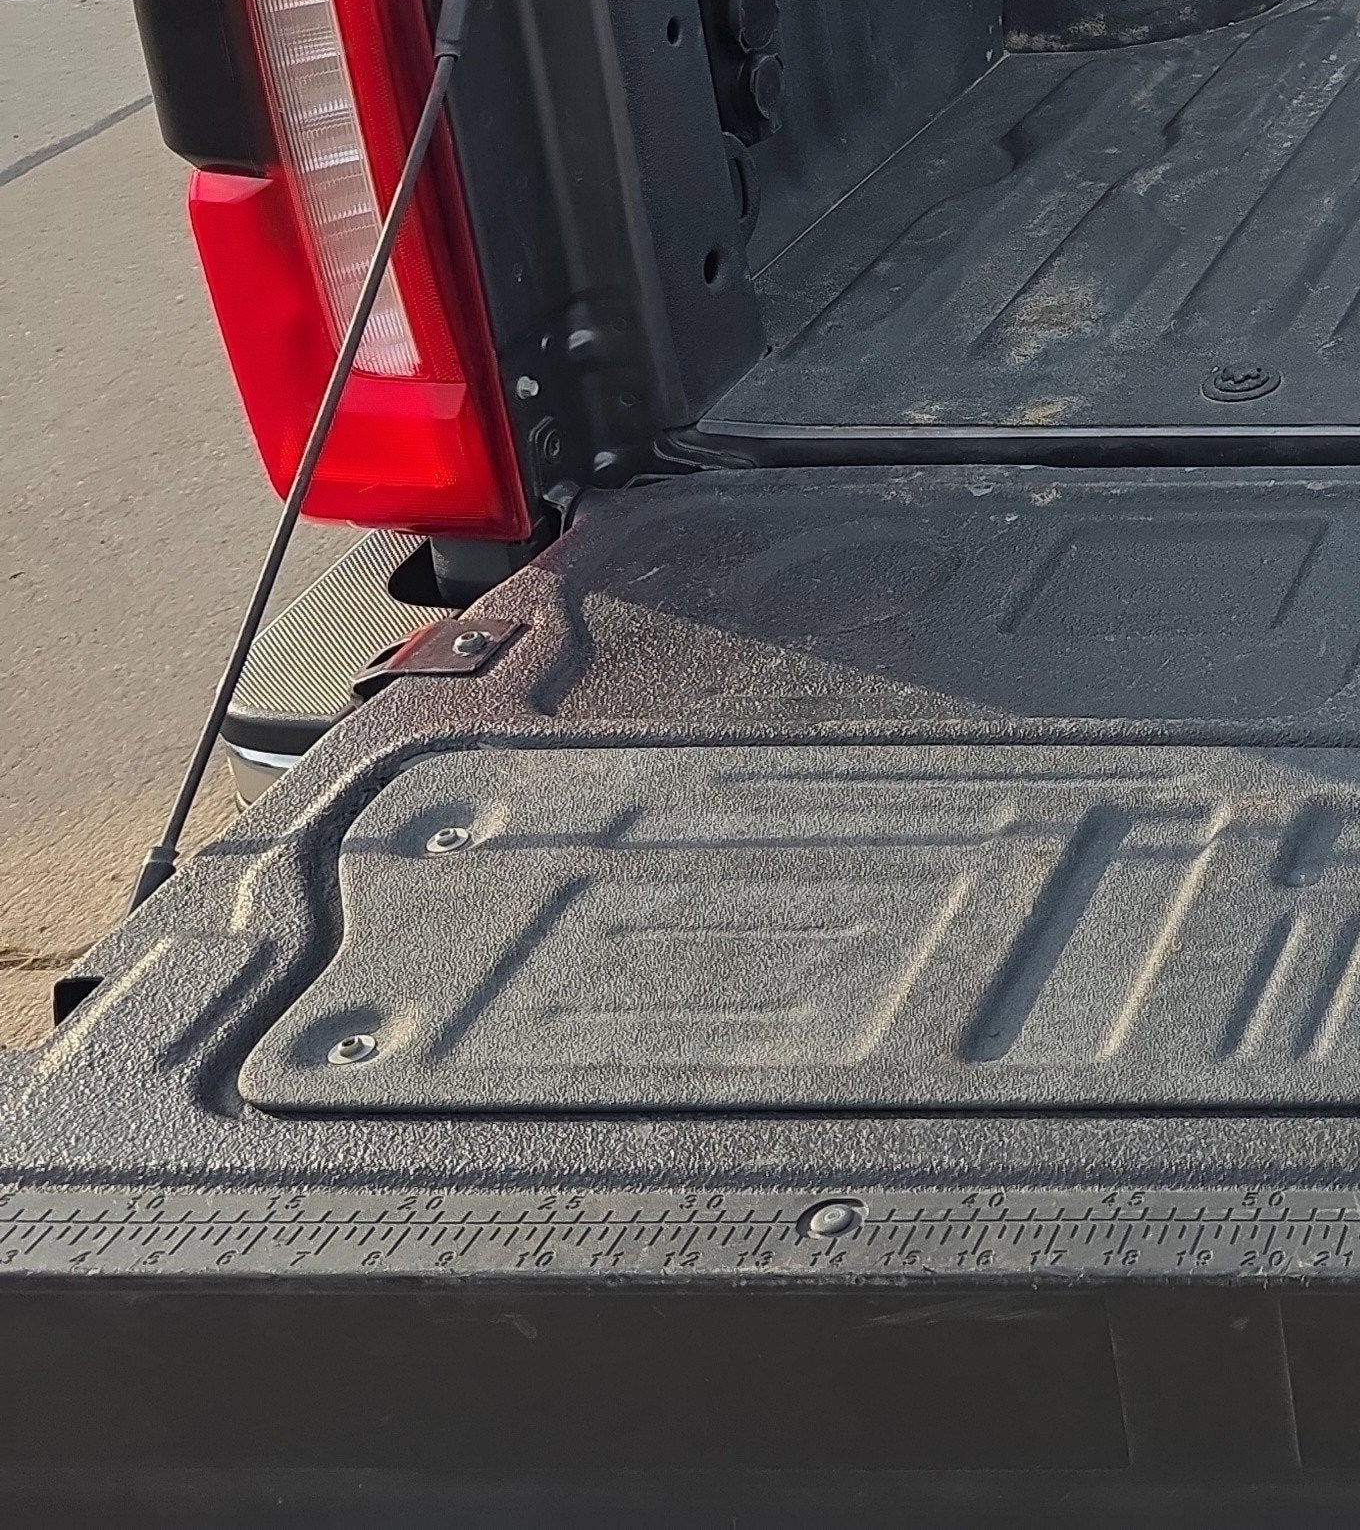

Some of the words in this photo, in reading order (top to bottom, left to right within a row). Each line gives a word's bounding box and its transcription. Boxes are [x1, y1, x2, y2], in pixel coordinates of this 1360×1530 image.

[266, 1194, 306, 1210] 15
[397, 1195, 443, 1210] 20
[538, 1195, 585, 1210] 25
[679, 1194, 724, 1210] 30
[961, 1192, 1005, 1208] 40
[1102, 1191, 1145, 1207] 45
[1242, 1192, 1284, 1207] 50
[0, 1250, 19, 1264] 3
[143, 1250, 167, 1266] 5
[216, 1250, 237, 1266] 6
[290, 1250, 311, 1266] 7
[361, 1250, 383, 1266] 8
[436, 1250, 457, 1267] 9
[517, 1251, 554, 1267] 10
[590, 1251, 625, 1267] 11
[665, 1251, 701, 1267] 12
[737, 1251, 774, 1267] 13
[810, 1250, 847, 1267] 14
[882, 1250, 922, 1267] 15
[957, 1250, 996, 1266] 16
[1030, 1250, 1068, 1266] 17
[1102, 1250, 1142, 1266] 18
[1176, 1250, 1214, 1266] 19
[1240, 1250, 1285, 1267] 20
[1313, 1250, 1353, 1267] 21
